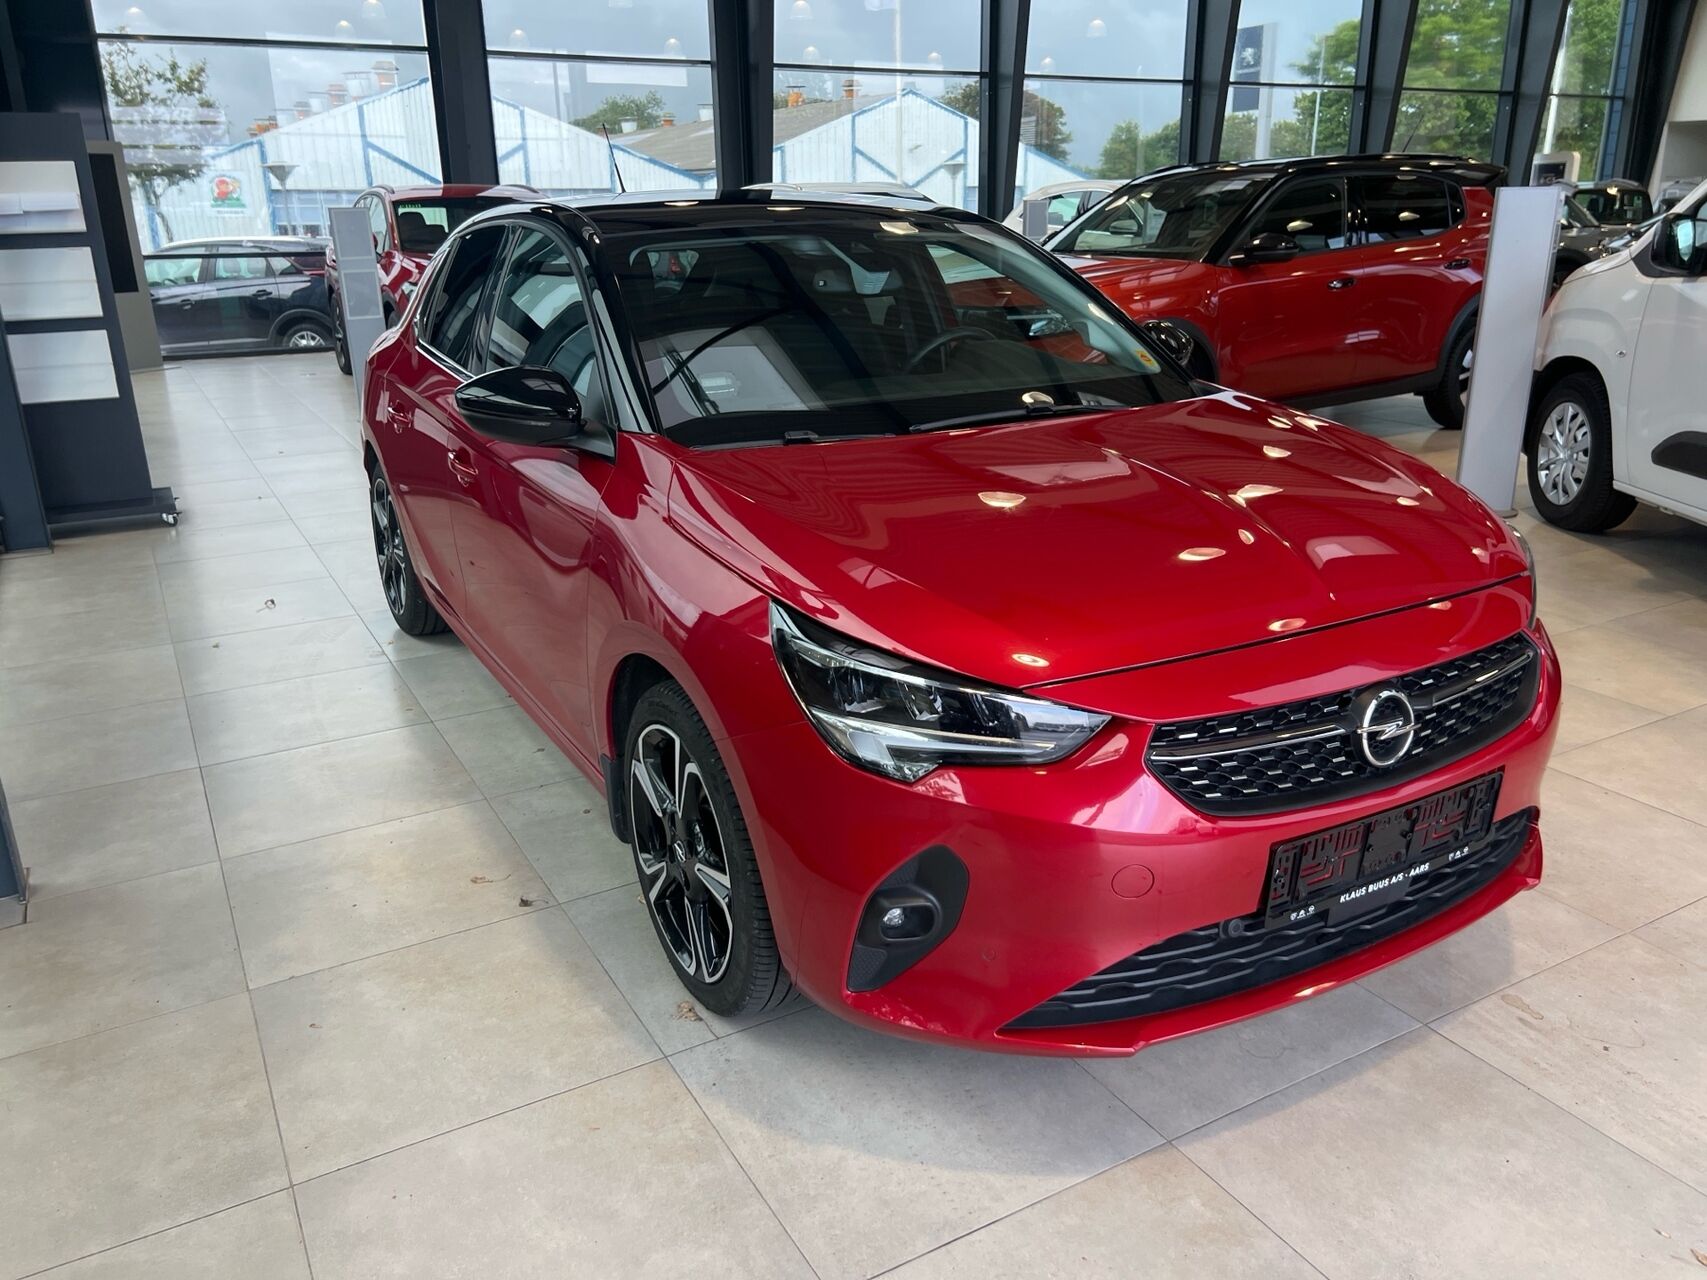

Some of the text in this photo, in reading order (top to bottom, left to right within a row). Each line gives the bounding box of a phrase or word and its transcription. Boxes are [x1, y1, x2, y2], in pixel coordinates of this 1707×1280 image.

[1339, 887, 1366, 903] KLAUS
[1368, 878, 1389, 893] BUUS
[1390, 872, 1404, 884] A/S
[1409, 862, 1430, 877] AARS
